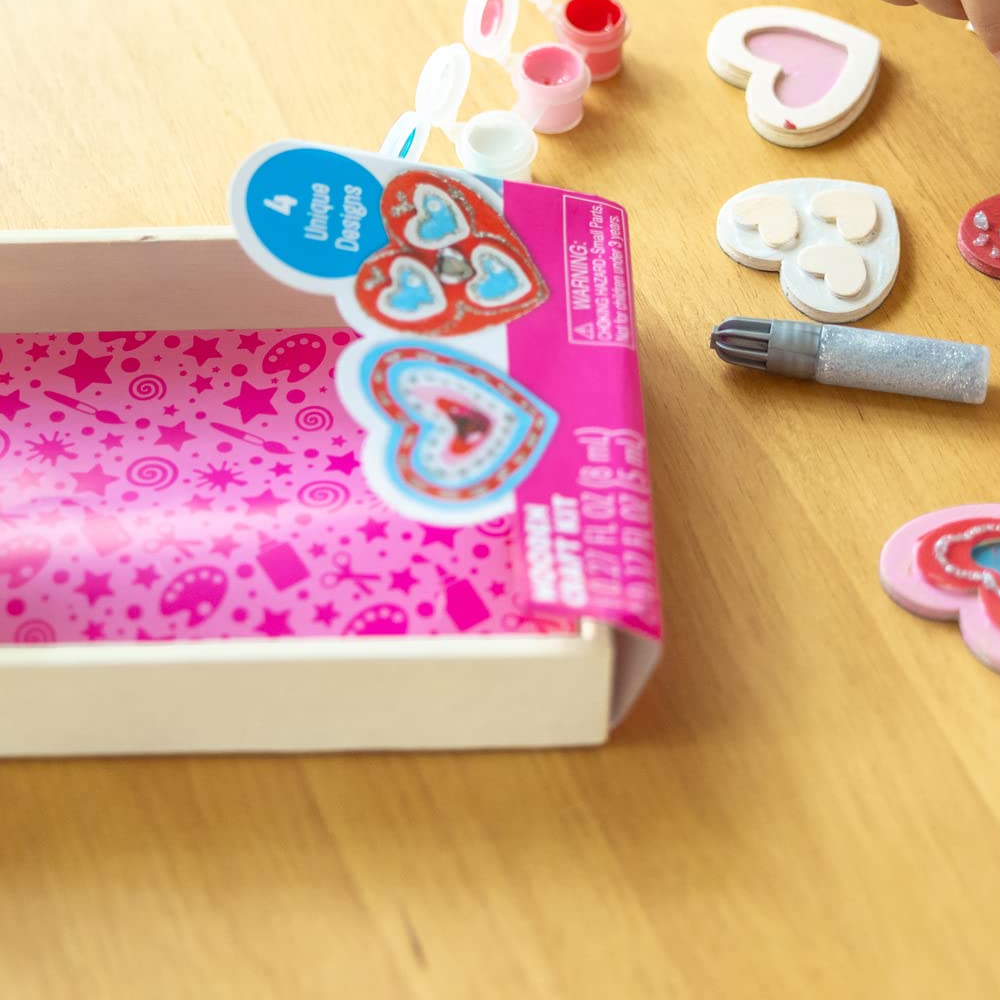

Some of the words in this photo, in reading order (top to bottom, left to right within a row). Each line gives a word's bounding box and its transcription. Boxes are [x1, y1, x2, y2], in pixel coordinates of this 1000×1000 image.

[263, 194, 298, 216] 4
[304, 182, 334, 241] Unique
[589, 203, 604, 228] Parts.
[335, 184, 367, 253] Designs
[609, 215, 625, 241] years.
[608, 240, 622, 248] 3
[569, 240, 591, 310] WARNING:
[609, 249, 625, 275] under
[612, 276, 628, 309] children
[596, 297, 612, 341] CHOKING
[614, 310, 628, 324] for
